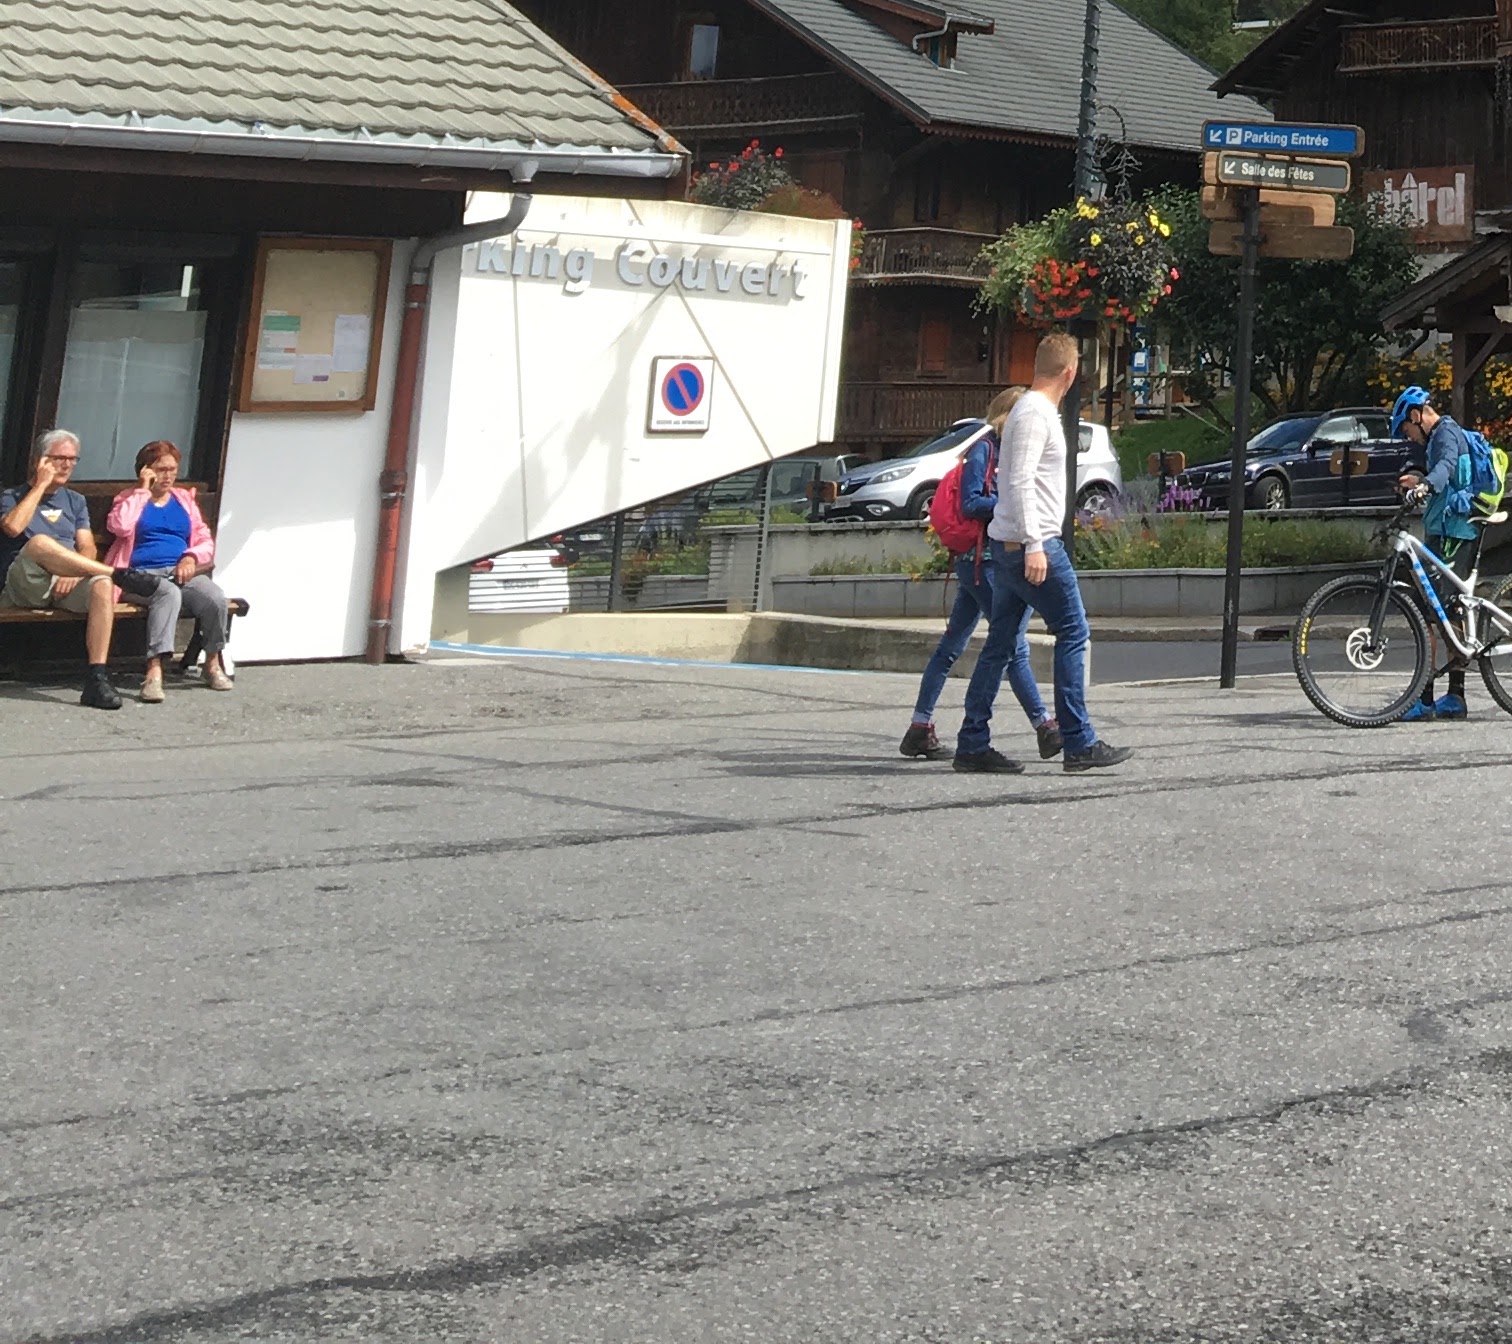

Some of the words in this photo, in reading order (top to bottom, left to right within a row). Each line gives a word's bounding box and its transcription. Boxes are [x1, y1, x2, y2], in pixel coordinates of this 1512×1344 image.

[1244, 130, 1288, 147] Parking
[1291, 132, 1329, 146] Entrée
[1241, 162, 1265, 176] Salle
[1267, 165, 1286, 179] des
[1288, 166, 1315, 181] Fêtes
[616, 241, 808, 301] Couvert
